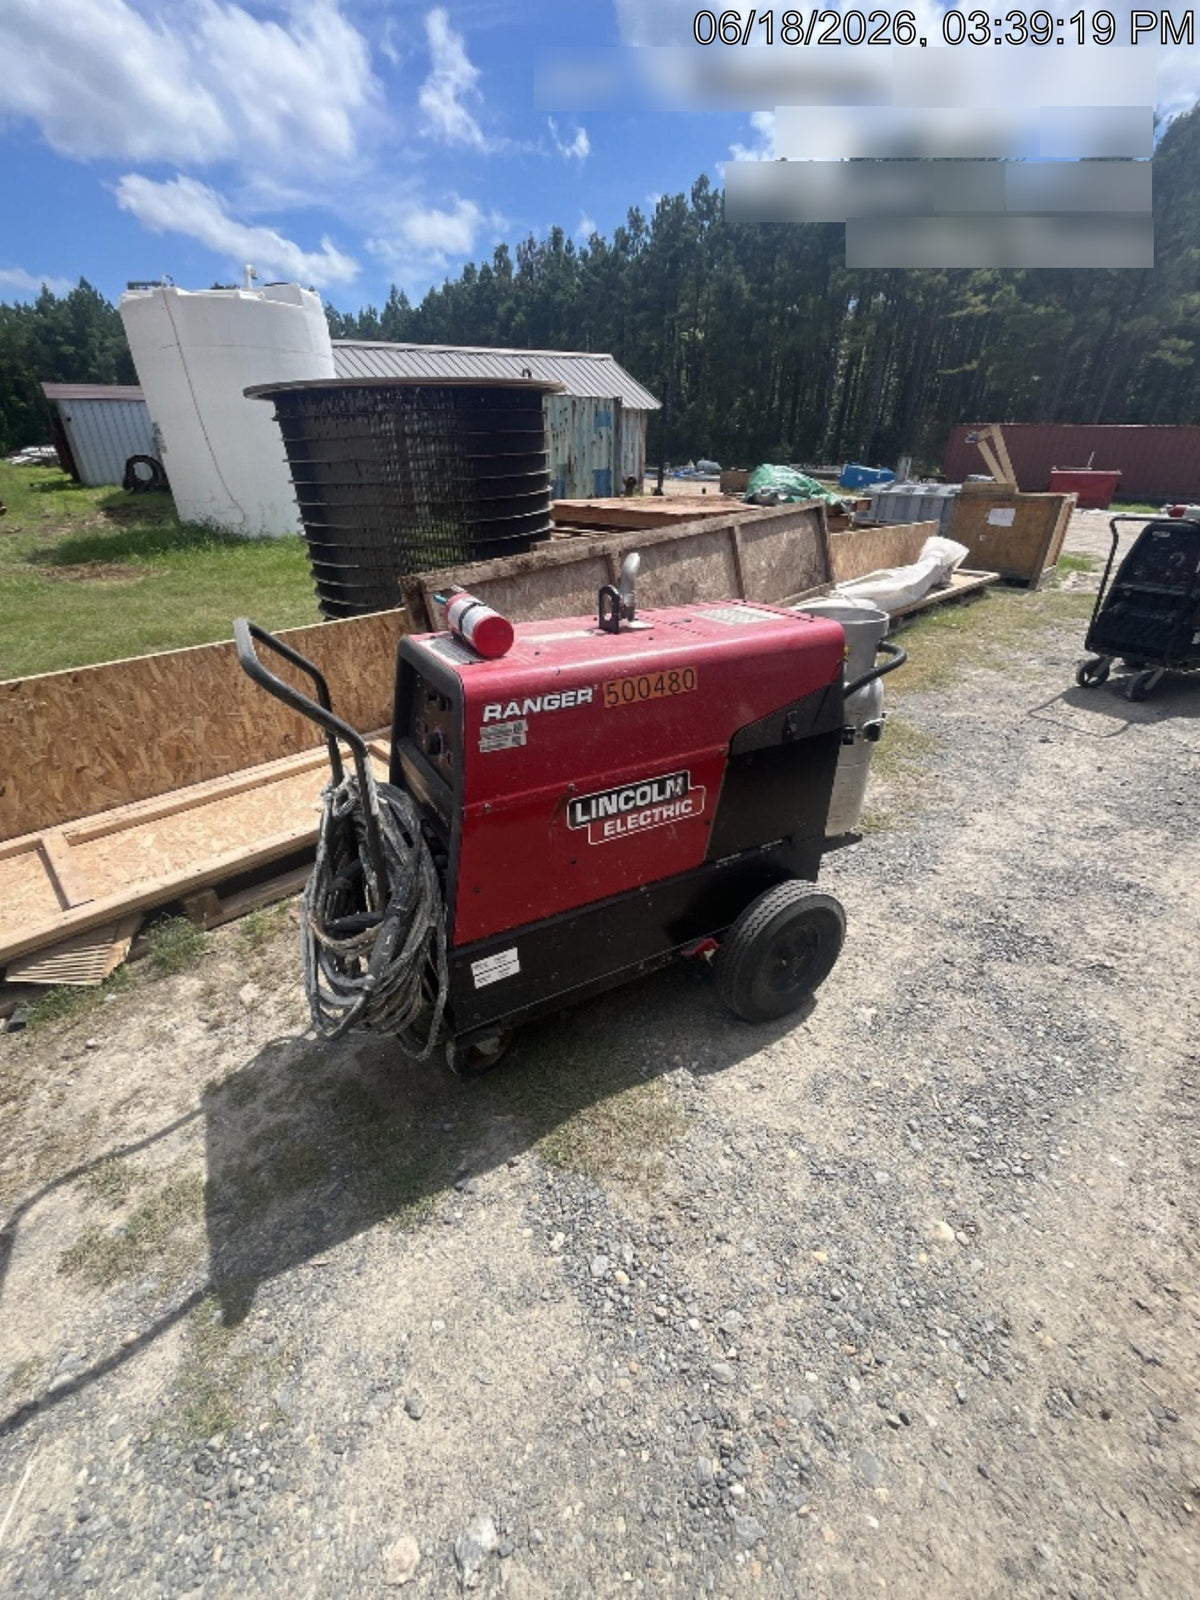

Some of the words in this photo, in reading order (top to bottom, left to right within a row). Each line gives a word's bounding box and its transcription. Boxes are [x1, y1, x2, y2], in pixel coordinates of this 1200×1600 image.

[482, 688, 593, 722] RANGER
[606, 668, 695, 706] 500480
[603, 799, 693, 837] ELECTRIC
